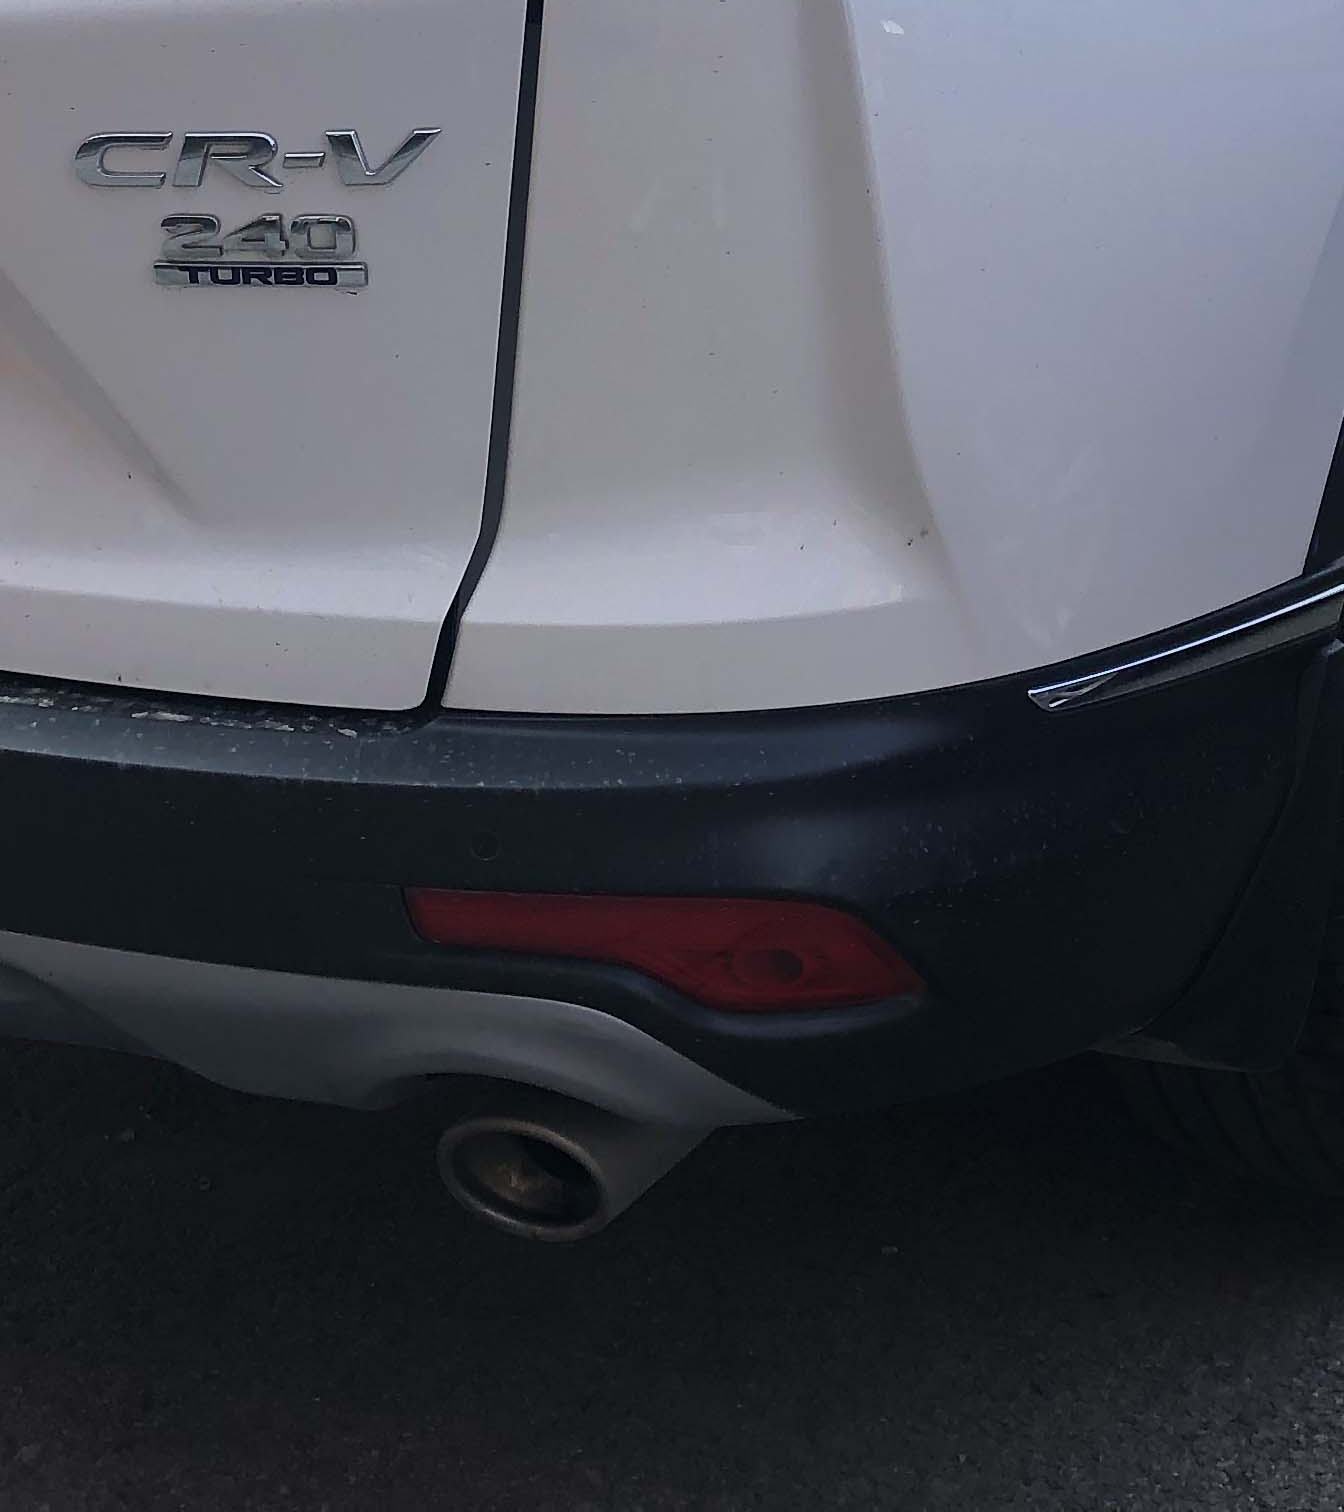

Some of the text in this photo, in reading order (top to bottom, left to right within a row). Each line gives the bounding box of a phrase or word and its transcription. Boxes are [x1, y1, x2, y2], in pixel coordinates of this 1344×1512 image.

[74, 127, 443, 188] CR-V
[159, 212, 359, 260] 240
[177, 265, 339, 287] TURBO
